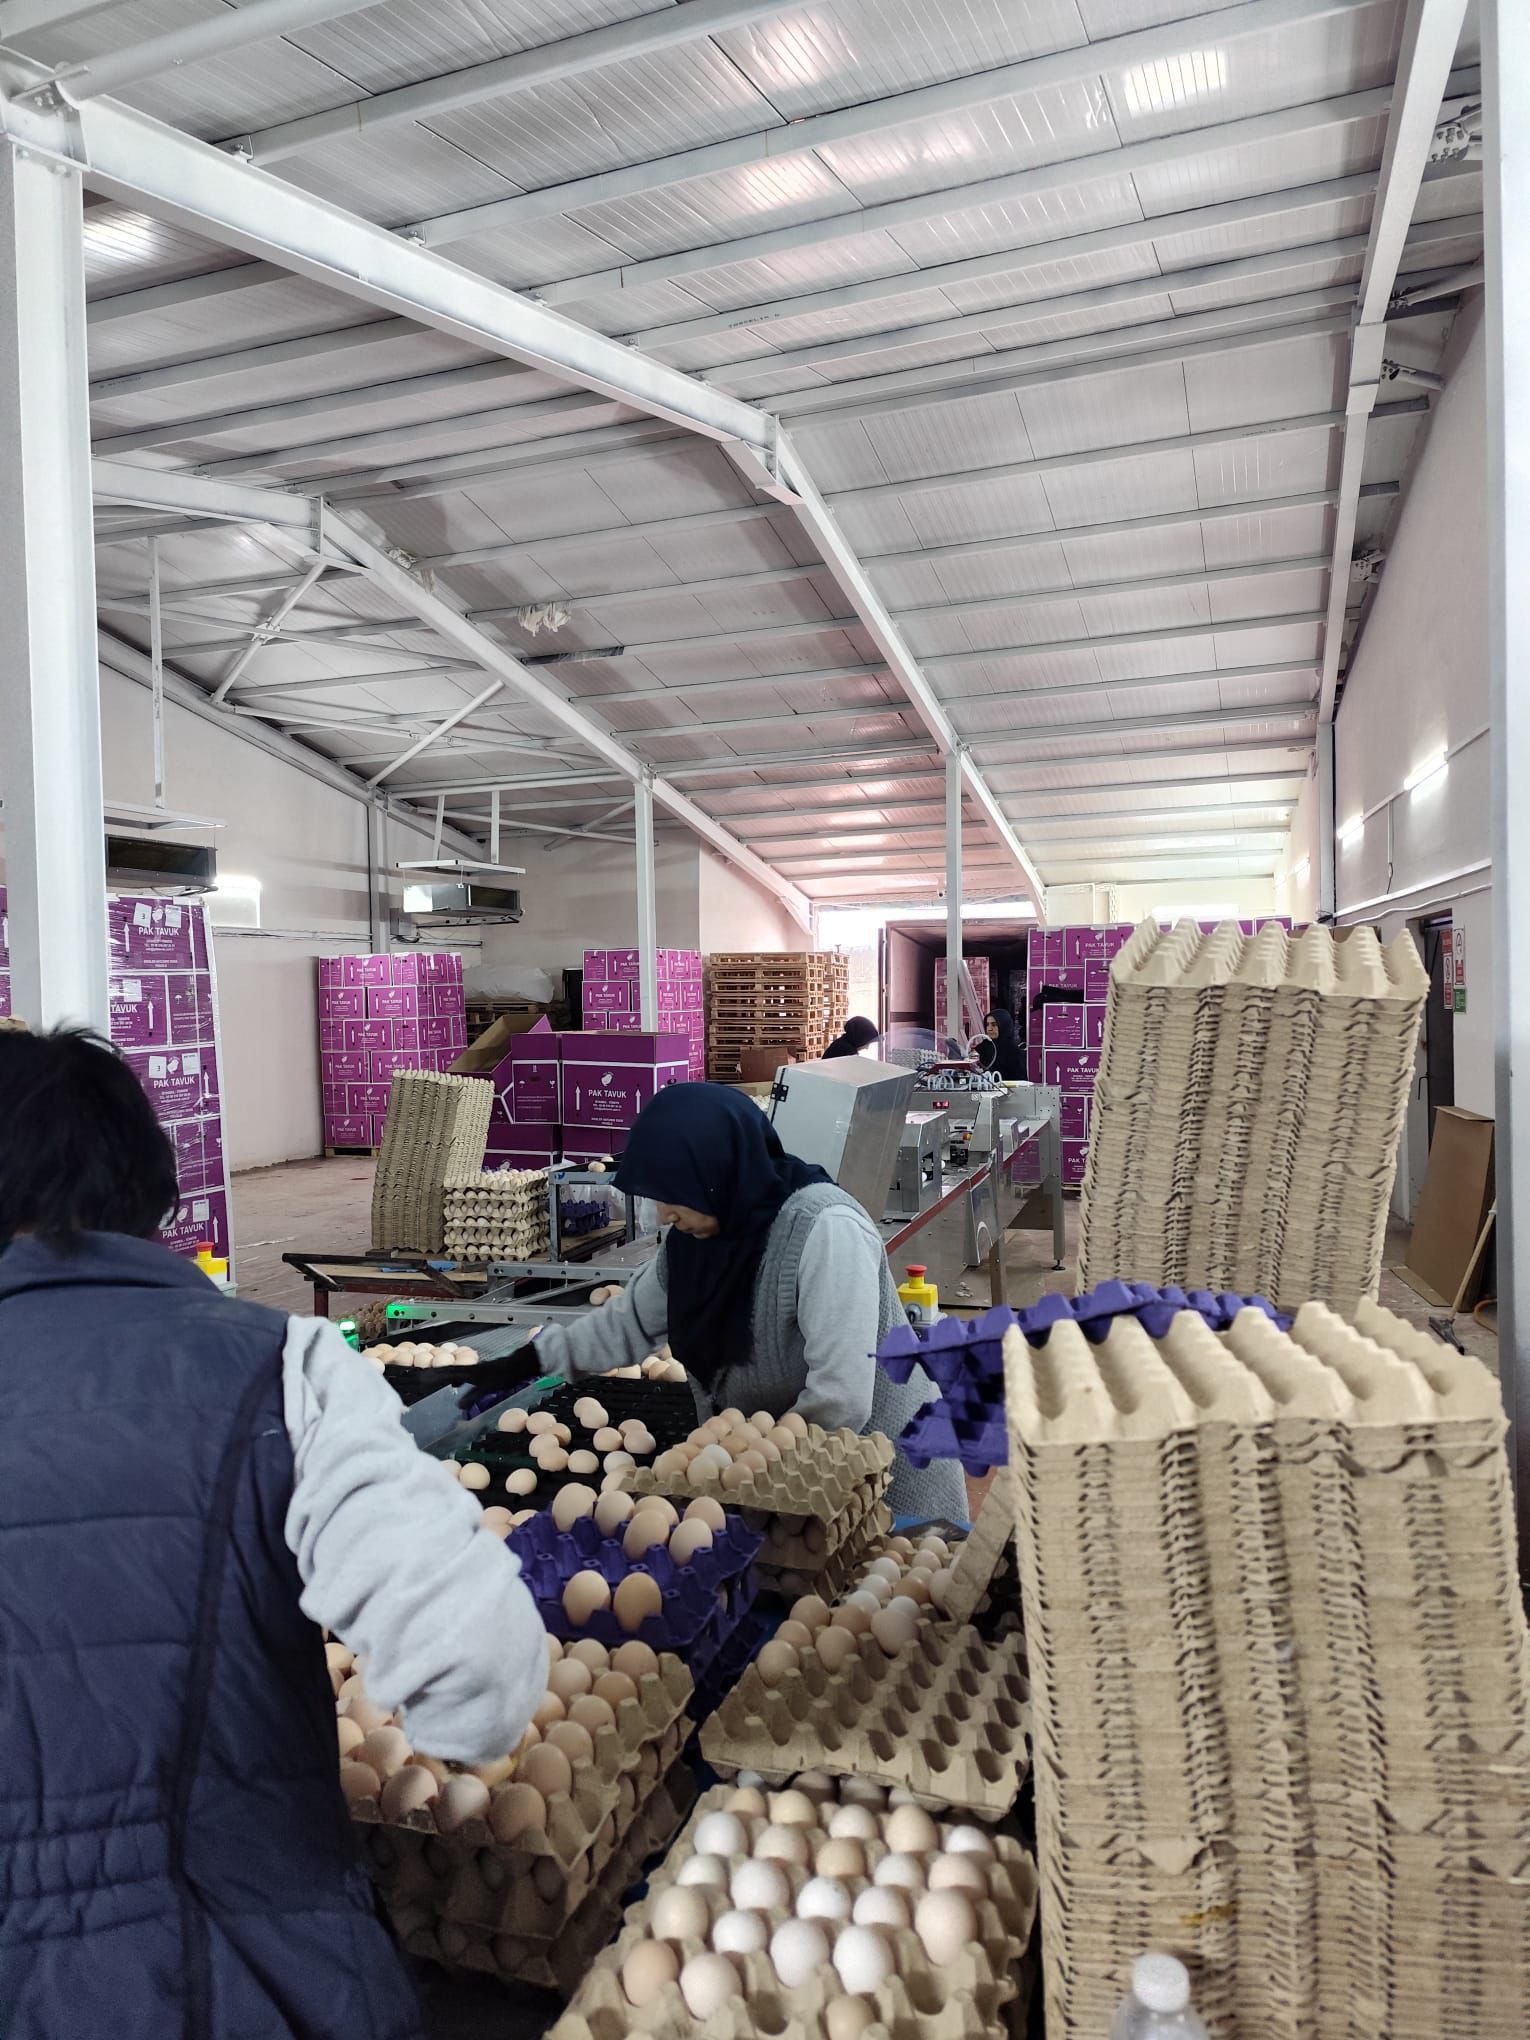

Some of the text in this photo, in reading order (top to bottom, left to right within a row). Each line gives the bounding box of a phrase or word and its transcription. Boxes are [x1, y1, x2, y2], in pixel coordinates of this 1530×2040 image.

[138, 926, 180, 936] PAK TAVUK
[111, 1004, 138, 1013] TAVUK
[153, 1076, 195, 1089] PAK TAVUK
[588, 1089, 627, 1099] PAK TAVUK
[162, 1222, 205, 1239] PAK TAVUK
